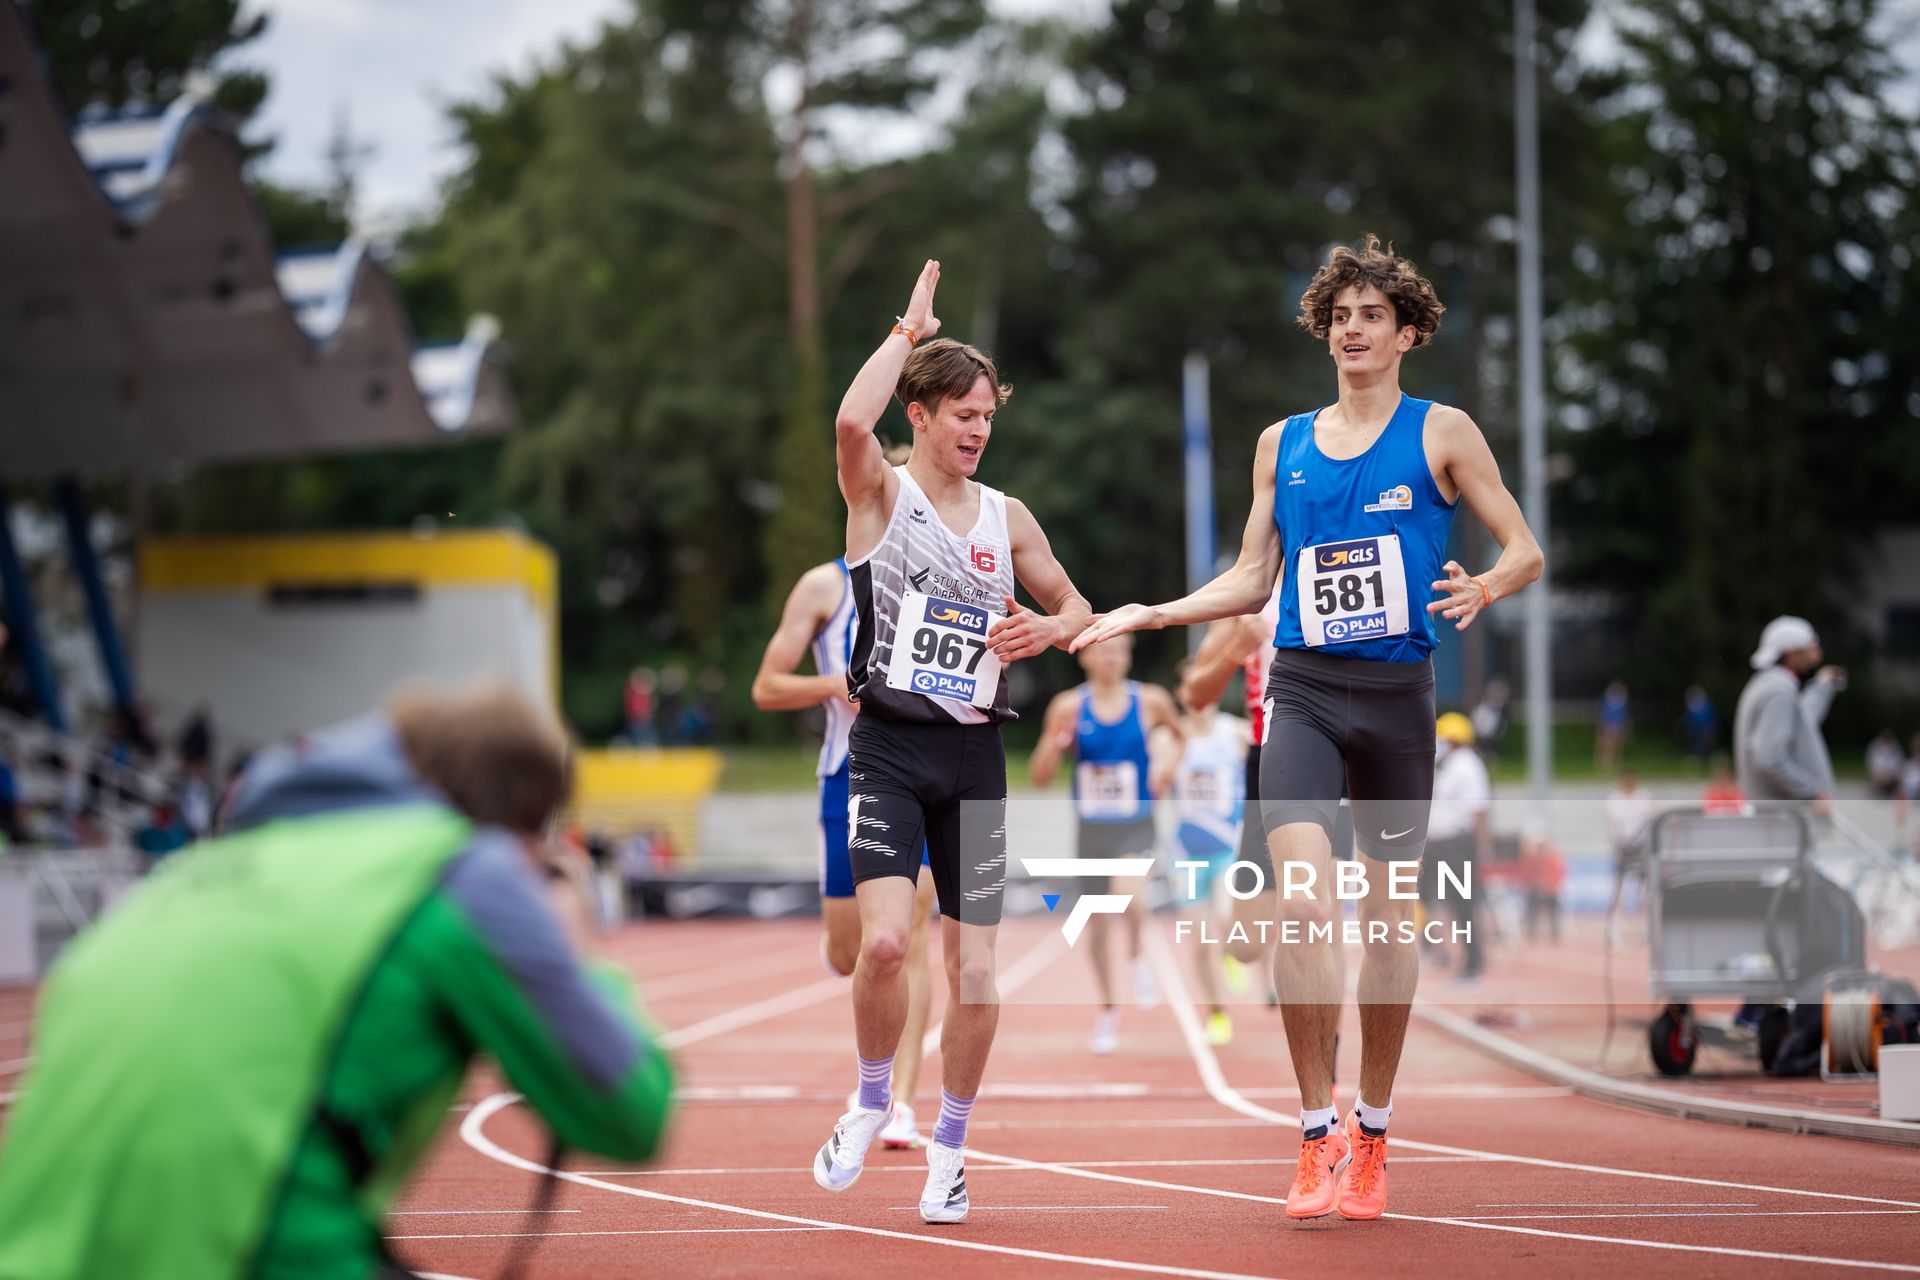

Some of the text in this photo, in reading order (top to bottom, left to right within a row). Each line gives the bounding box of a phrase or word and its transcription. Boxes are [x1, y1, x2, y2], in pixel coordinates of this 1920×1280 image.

[1347, 547, 1374, 563] GLS
[1314, 570, 1385, 616] 581
[958, 611, 984, 629] GLS
[1349, 616, 1385, 631] PLAN
[911, 626, 988, 675] 967
[938, 676, 974, 695] PLAN
